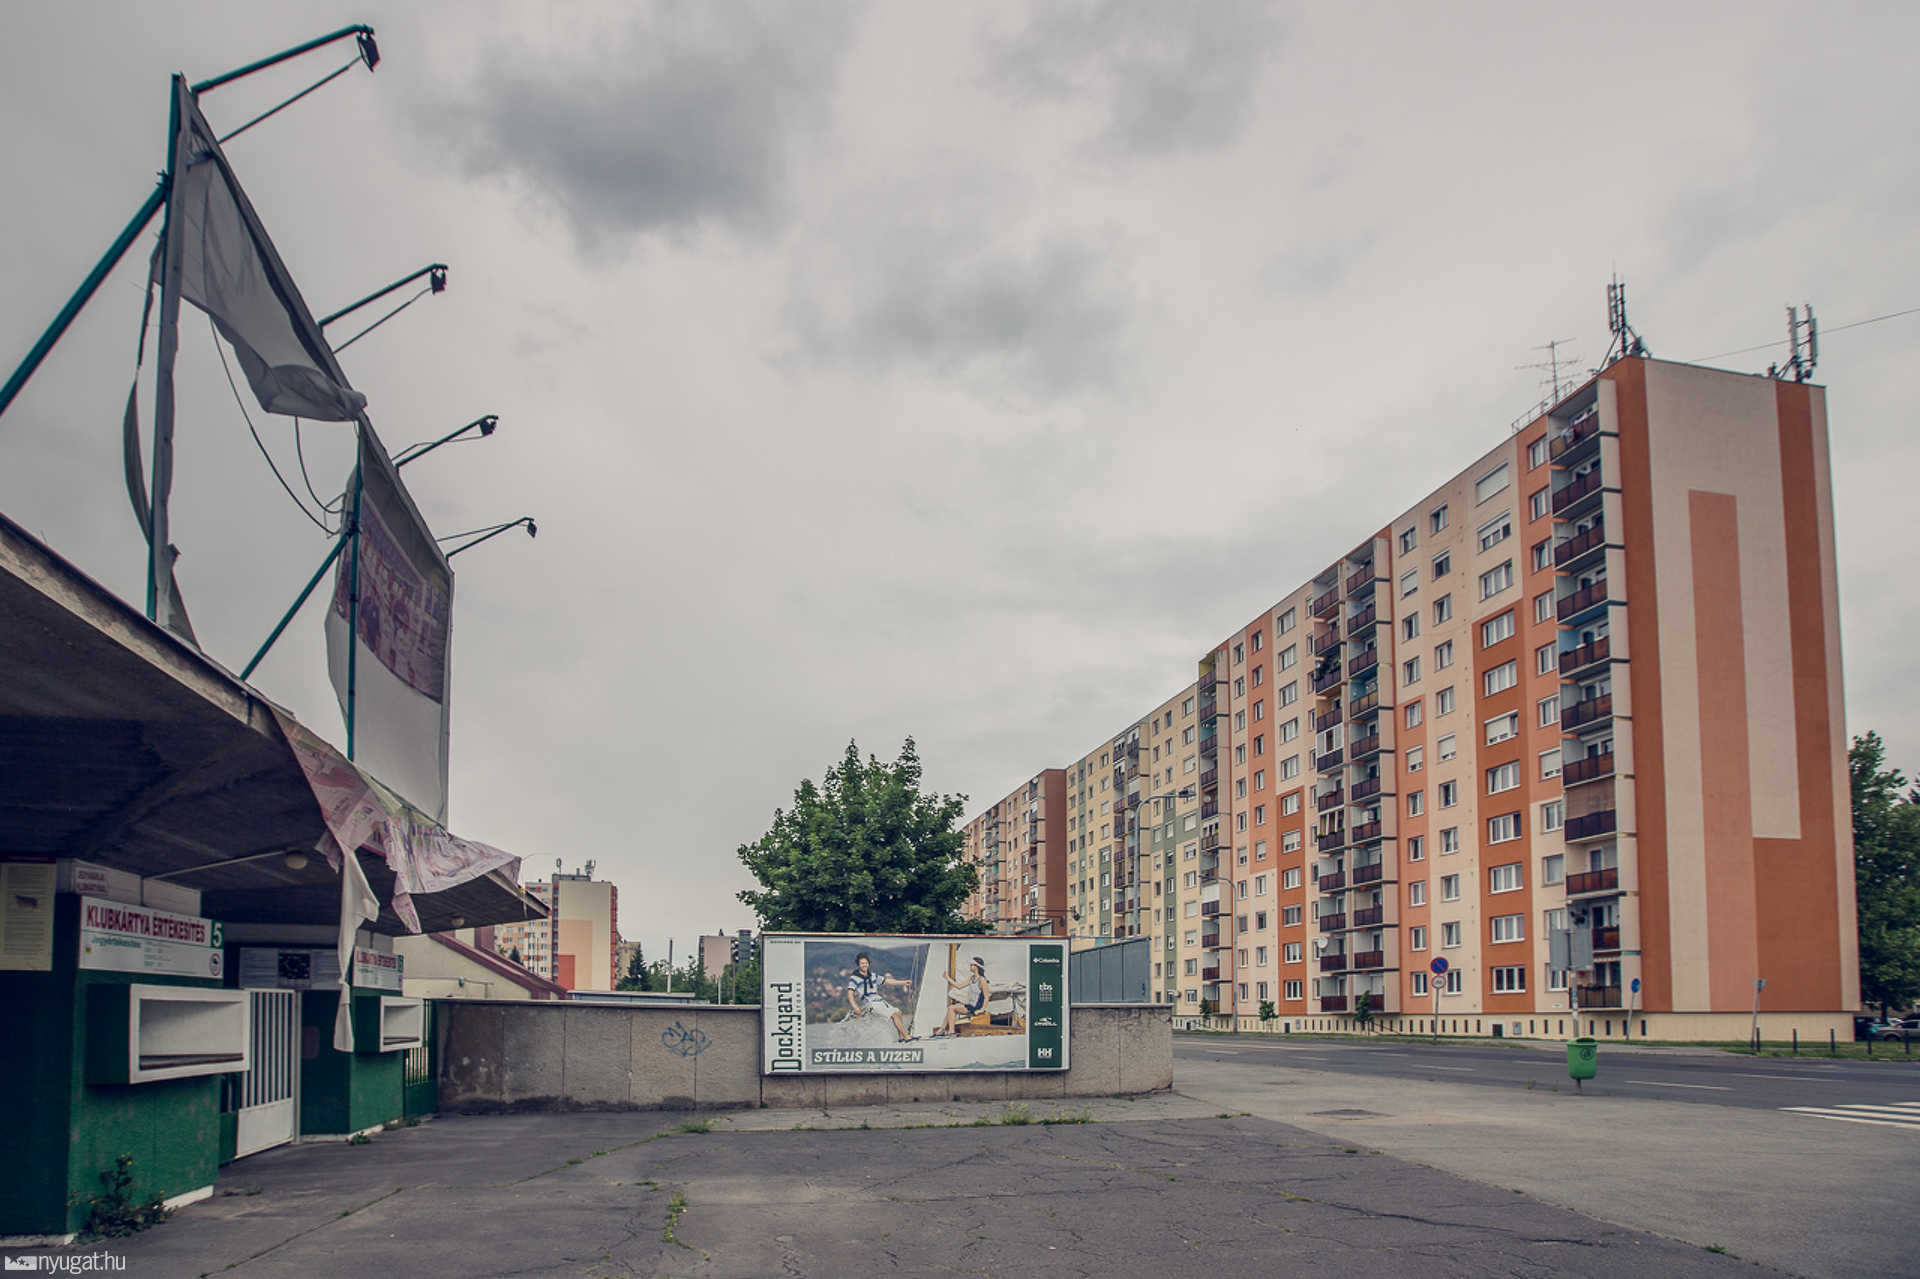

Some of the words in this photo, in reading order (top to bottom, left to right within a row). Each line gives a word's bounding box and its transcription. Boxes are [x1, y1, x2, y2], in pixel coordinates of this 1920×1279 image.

[86, 904, 150, 936] KLUBKÁRTYA
[212, 922, 223, 948] 5
[770, 982, 802, 1072] Dockyard
[814, 1049, 864, 1063] STÍLUS
[866, 1050, 876, 1063] A
